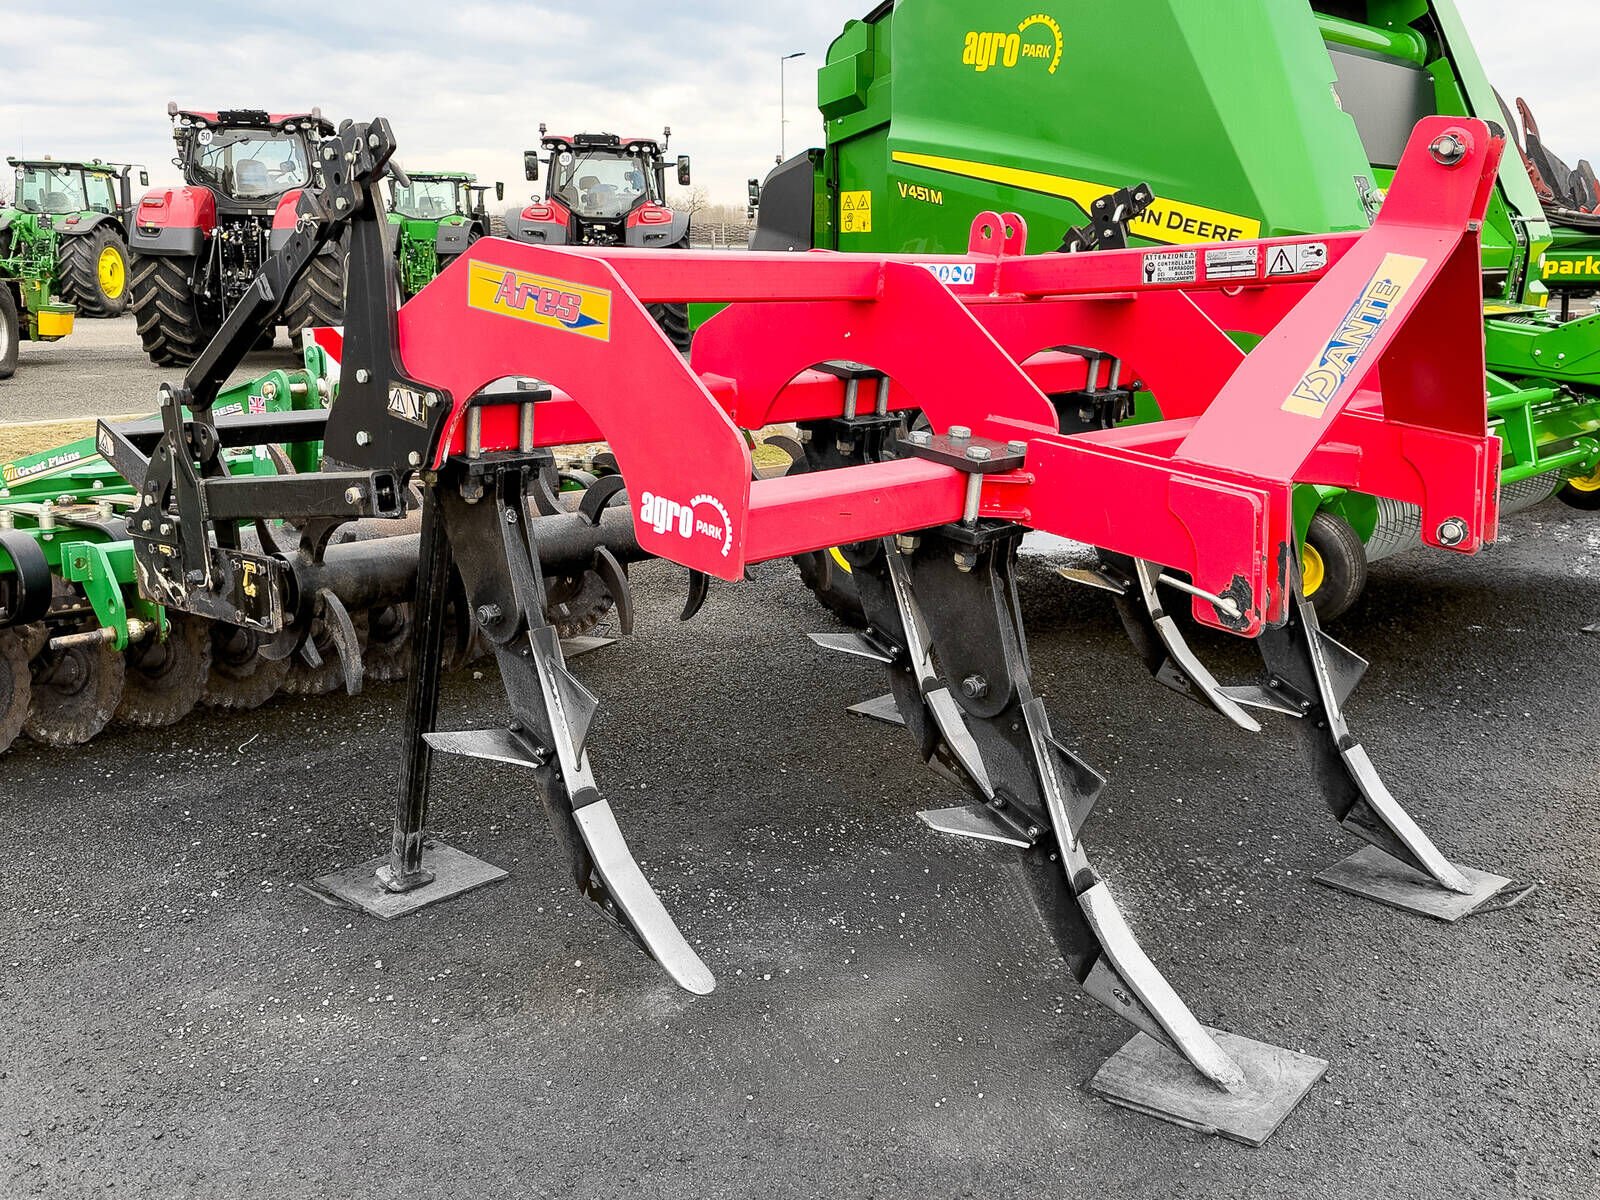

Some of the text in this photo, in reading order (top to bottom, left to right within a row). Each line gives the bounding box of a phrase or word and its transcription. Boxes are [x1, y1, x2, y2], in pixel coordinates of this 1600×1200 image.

[963, 32, 1051, 71] agro PARK
[201, 132, 210, 141] 50
[898, 182, 943, 205] V451M
[1167, 211, 1242, 241] DEERE
[494, 271, 581, 322] Ares
[1292, 281, 1400, 402] DANTE
[18, 452, 80, 476] Great Plains
[640, 491, 722, 540] agro PARK
